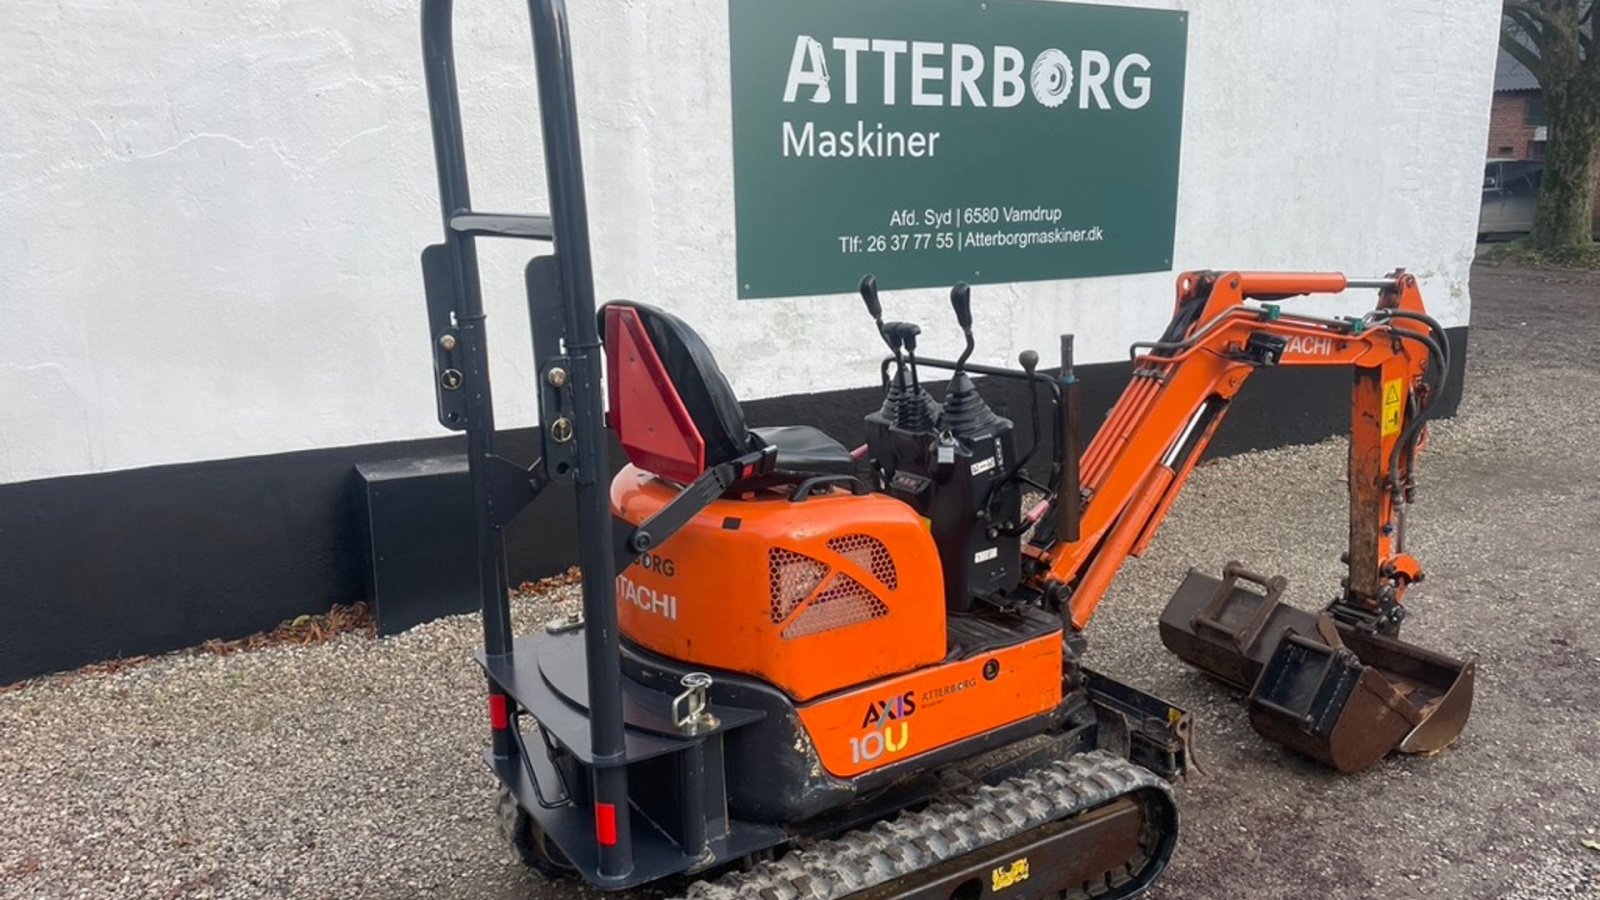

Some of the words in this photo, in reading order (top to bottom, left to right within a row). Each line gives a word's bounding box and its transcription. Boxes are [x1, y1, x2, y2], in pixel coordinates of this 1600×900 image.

[782, 35, 1151, 110] ATTERBORG
[782, 120, 941, 158] Maskiner
[889, 209, 920, 227] Afd.
[924, 208, 952, 229] Syd
[963, 207, 1000, 224] 6580
[1002, 205, 1063, 224] Vamdrup
[838, 235, 863, 253] Tlf:
[866, 235, 887, 252] 26
[890, 234, 910, 251] 37
[913, 233, 932, 250] 77
[935, 232, 954, 249] 55
[964, 226, 1104, 249] Atterborgmaskiner.dk
[1283, 335, 1332, 356] TACHI
[615, 573, 677, 620] ITACHI
[861, 690, 917, 731] AXIS
[849, 721, 909, 765] 10U
